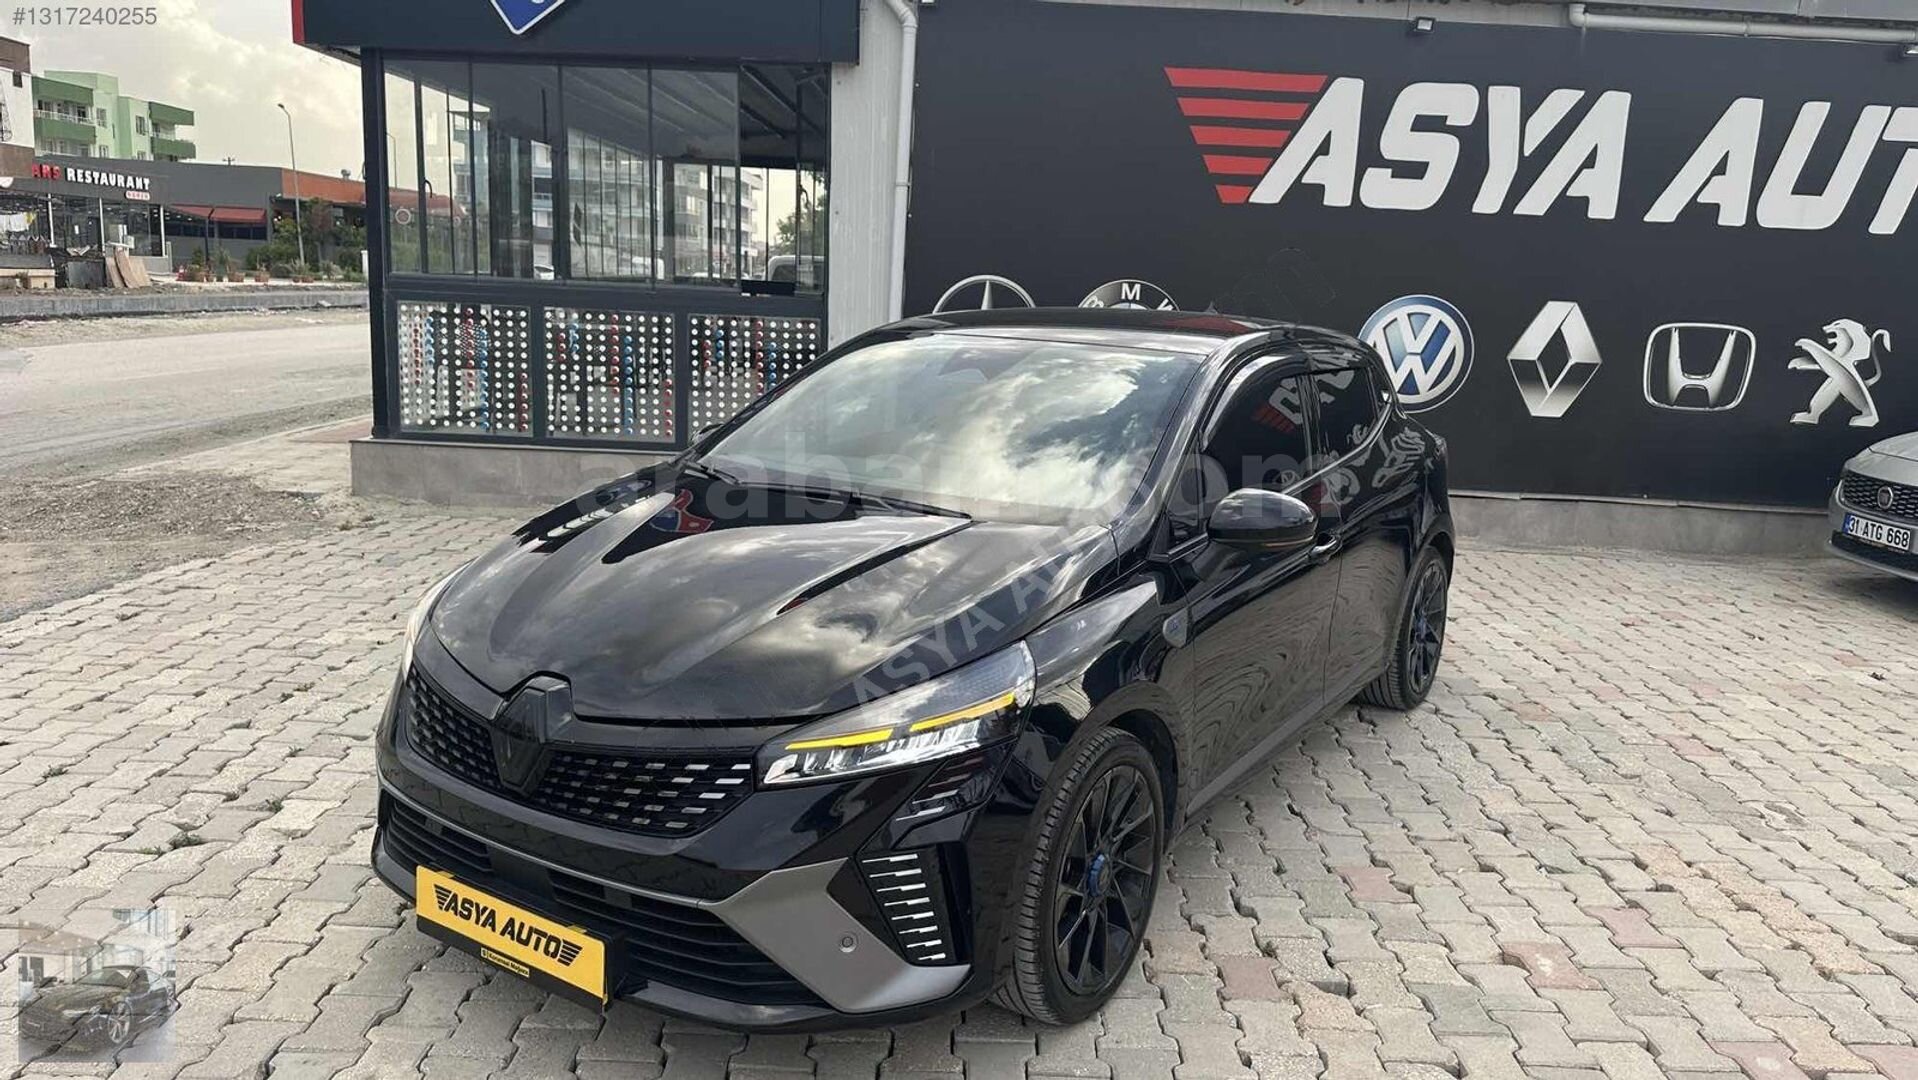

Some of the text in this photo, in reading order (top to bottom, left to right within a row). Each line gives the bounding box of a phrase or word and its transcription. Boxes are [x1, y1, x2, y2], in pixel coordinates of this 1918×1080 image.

[1248, 76, 1632, 220] ASYA
[66, 167, 150, 190] RESTAURANT
[1849, 517, 1859, 534] 31
[1862, 521, 1882, 540] ATG
[1886, 527, 1909, 547] 668
[444, 893, 562, 961] ASYA AUTO
